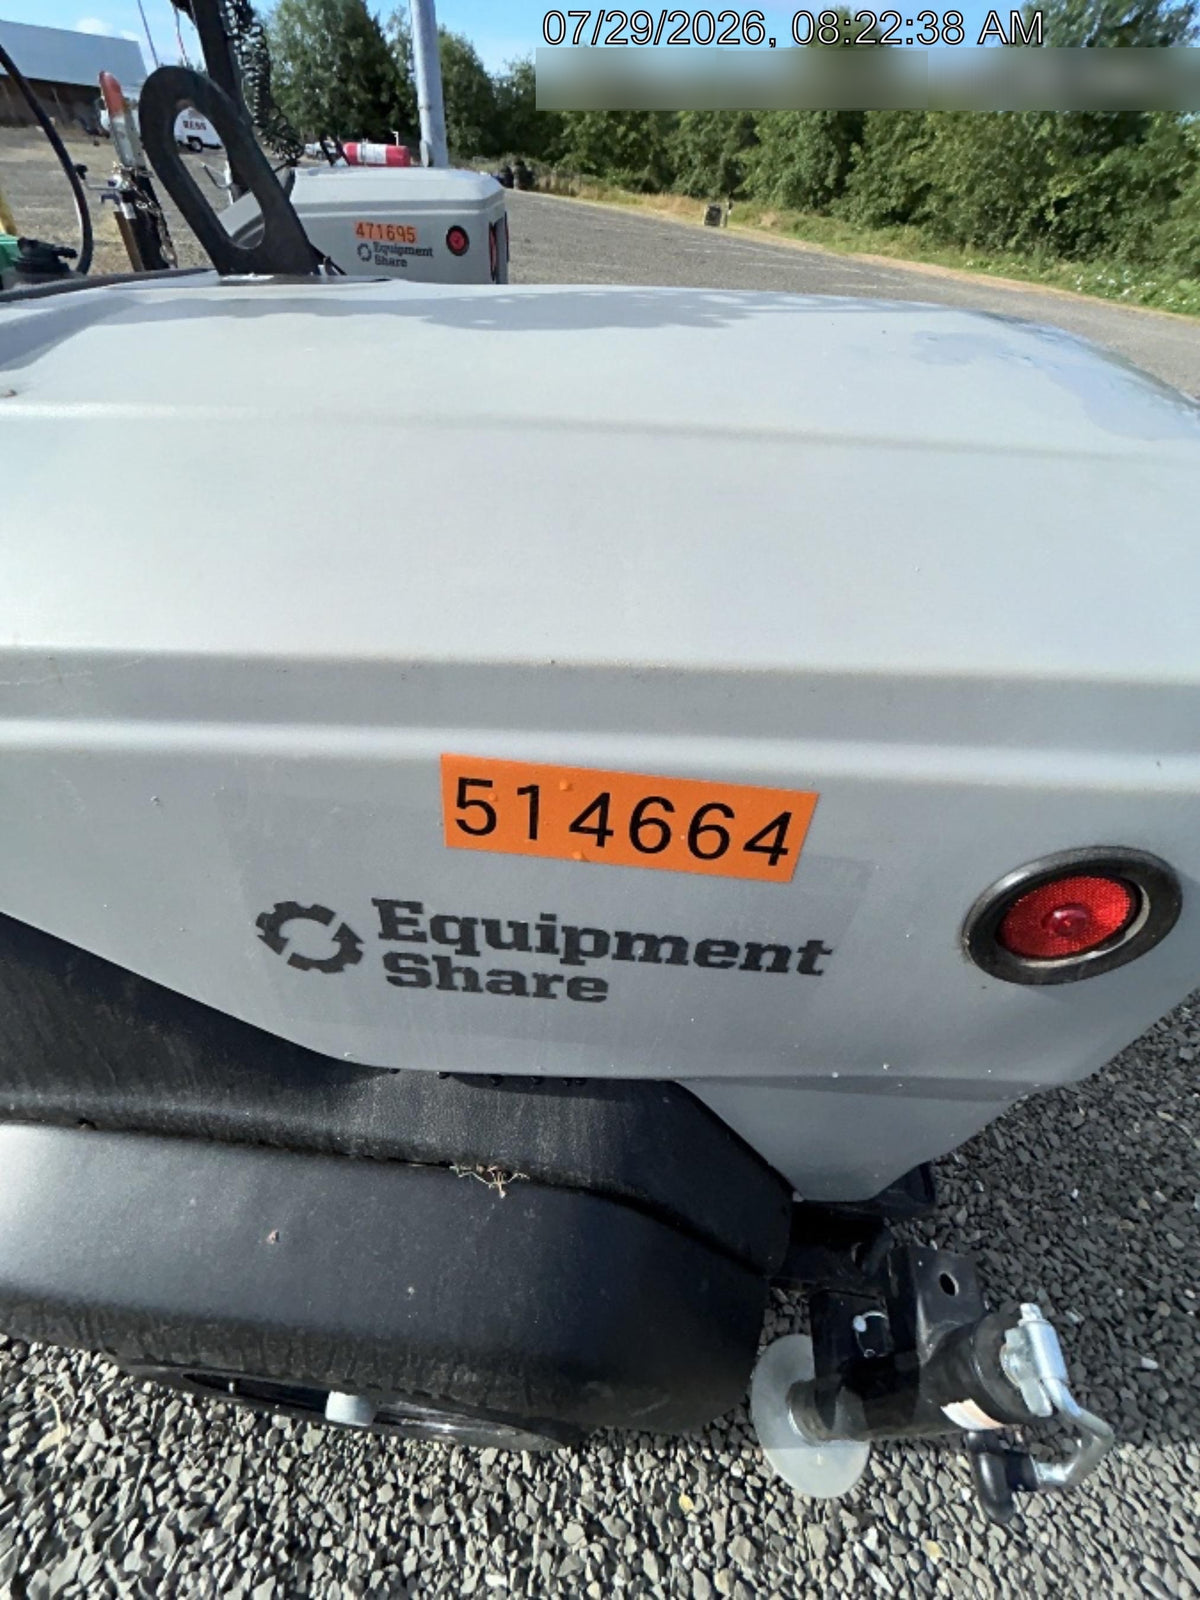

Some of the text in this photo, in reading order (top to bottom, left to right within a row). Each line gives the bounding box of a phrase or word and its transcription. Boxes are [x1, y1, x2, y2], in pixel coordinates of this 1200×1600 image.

[356, 223, 416, 243] 471695
[373, 241, 433, 257] Equipment
[375, 255, 408, 267] Share
[454, 776, 794, 866] 514664
[371, 898, 833, 976] Equipment
[382, 952, 609, 1003] Share
